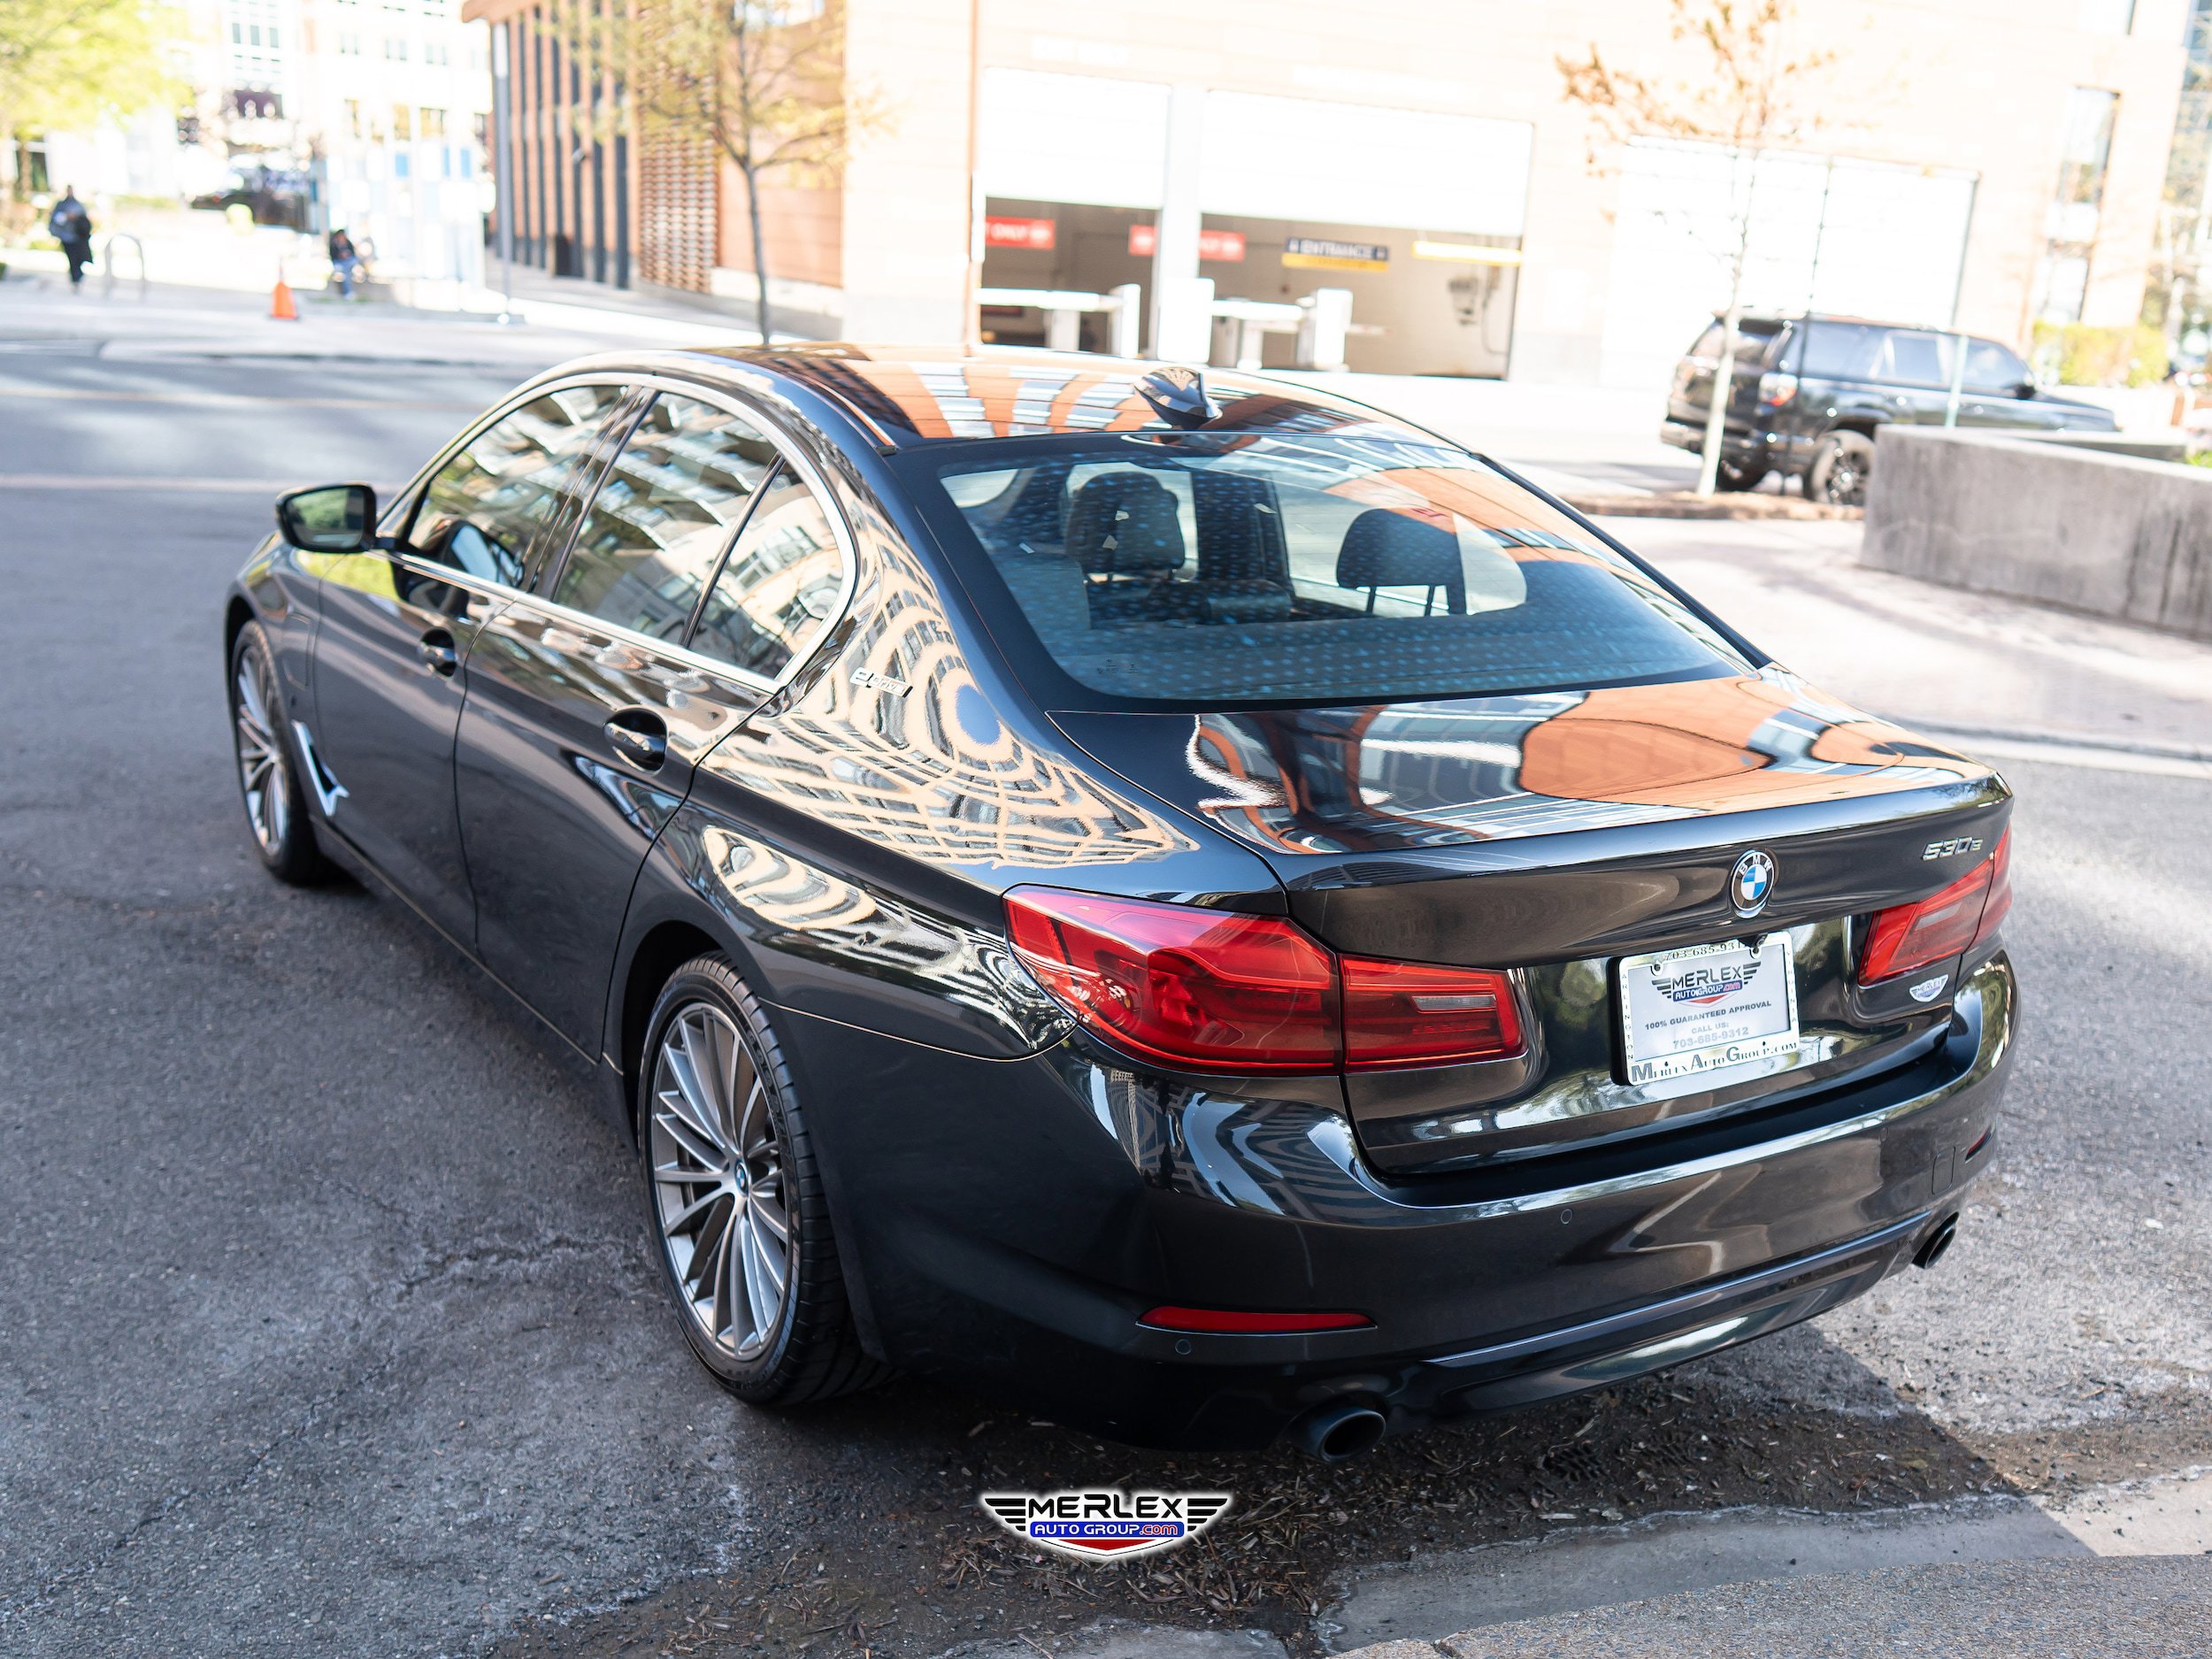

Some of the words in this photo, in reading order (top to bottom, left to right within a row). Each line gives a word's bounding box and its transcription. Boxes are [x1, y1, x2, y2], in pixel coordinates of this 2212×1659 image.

[1301, 238, 1372, 261] ENTRANCE
[1739, 854, 1772, 875] BMW
[1665, 941, 1746, 961] 703-685-931
[1672, 966, 1742, 990] MERLEX
[1645, 1020, 1668, 1031] 100%
[1670, 1009, 1726, 1025] GUARANTEED
[1729, 1000, 1772, 1014] APPROVAL
[1673, 1026, 1749, 1049] 703-685-9312
[1691, 1024, 1713, 1034] CALL
